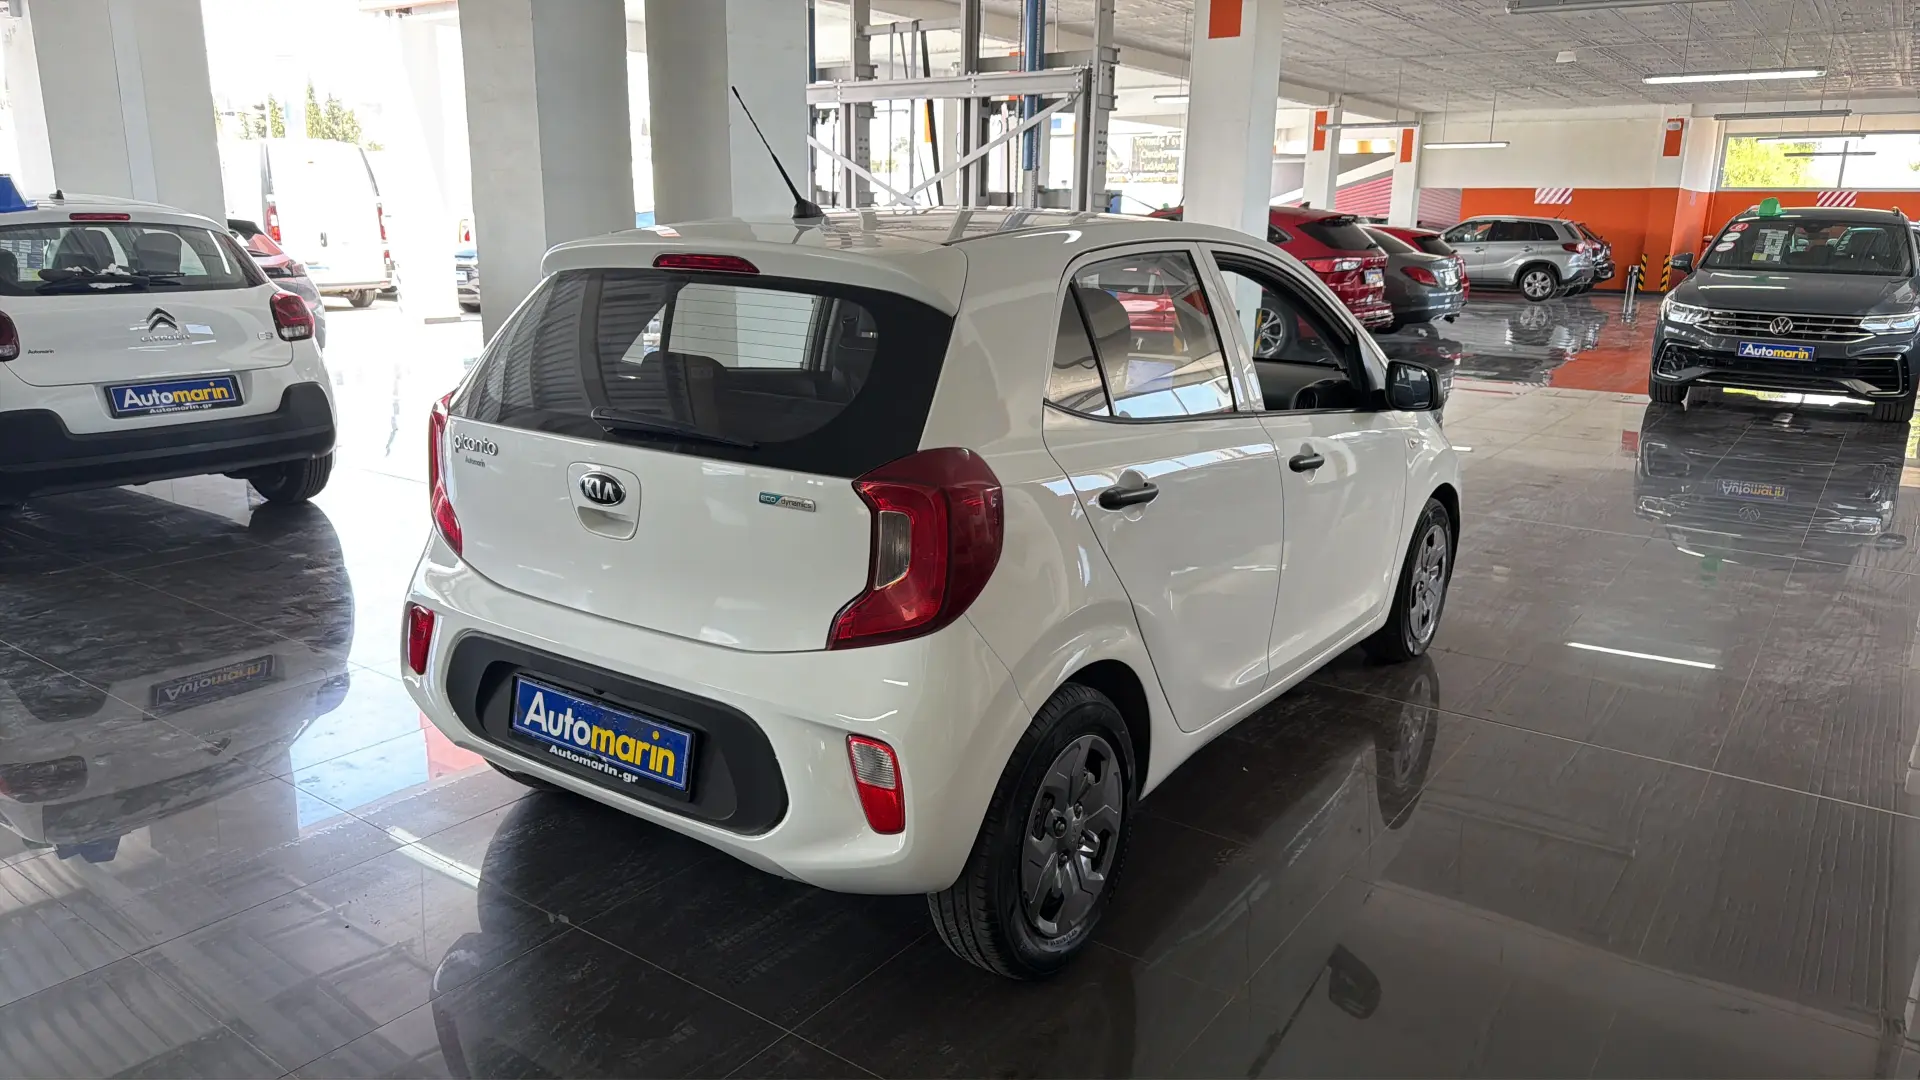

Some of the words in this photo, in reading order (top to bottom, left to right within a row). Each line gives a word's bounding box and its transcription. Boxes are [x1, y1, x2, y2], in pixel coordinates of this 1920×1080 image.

[257, 331, 273, 341] C3
[1743, 343, 1809, 359] Automarin
[123, 381, 230, 408] Automarin
[149, 403, 213, 414] Automarin.gr
[454, 432, 499, 456] picanto
[582, 477, 617, 502] KIA
[780, 498, 812, 509] dynamics
[523, 691, 676, 777] Automarin
[549, 745, 639, 784] Automarin.gr
